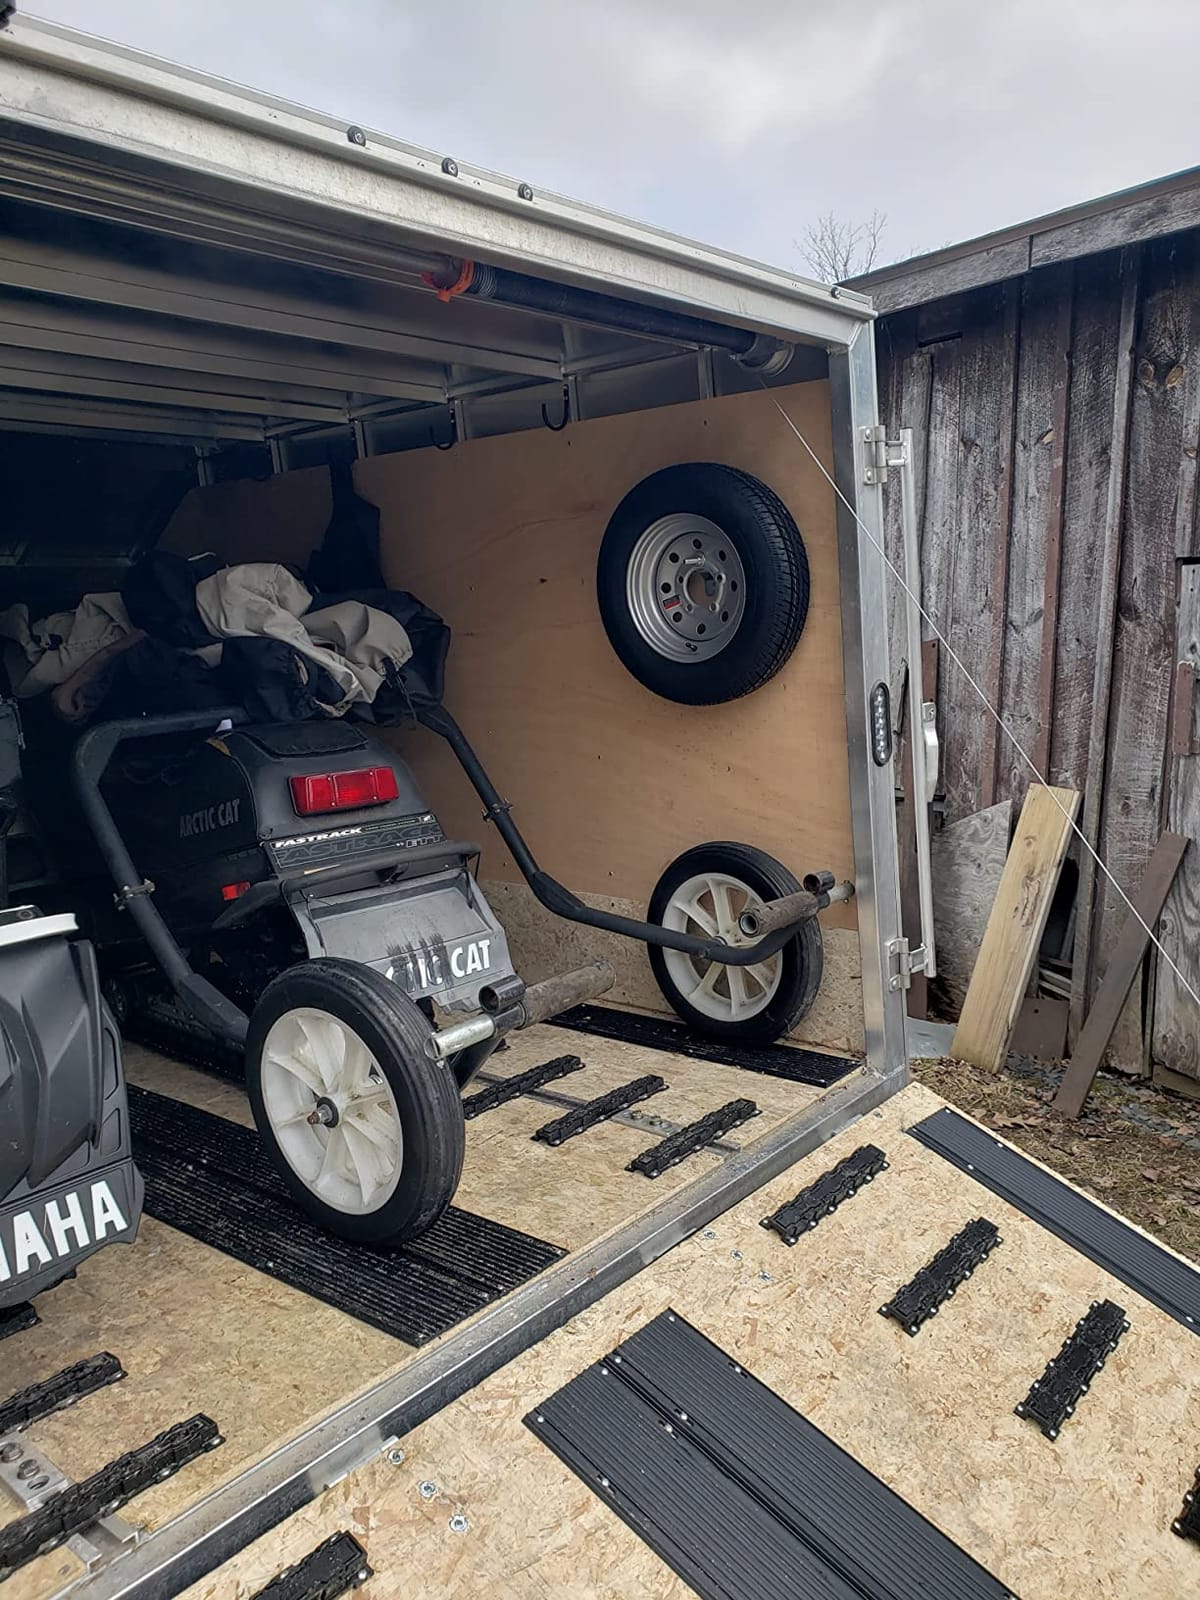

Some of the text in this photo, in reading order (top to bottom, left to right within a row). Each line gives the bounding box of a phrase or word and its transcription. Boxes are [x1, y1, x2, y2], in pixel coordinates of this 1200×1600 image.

[179, 797, 241, 839] ARCTIC CAT
[275, 827, 363, 849] FASTRACK
[451, 940, 491, 978] CAT
[0, 1180, 128, 1282] AHA
